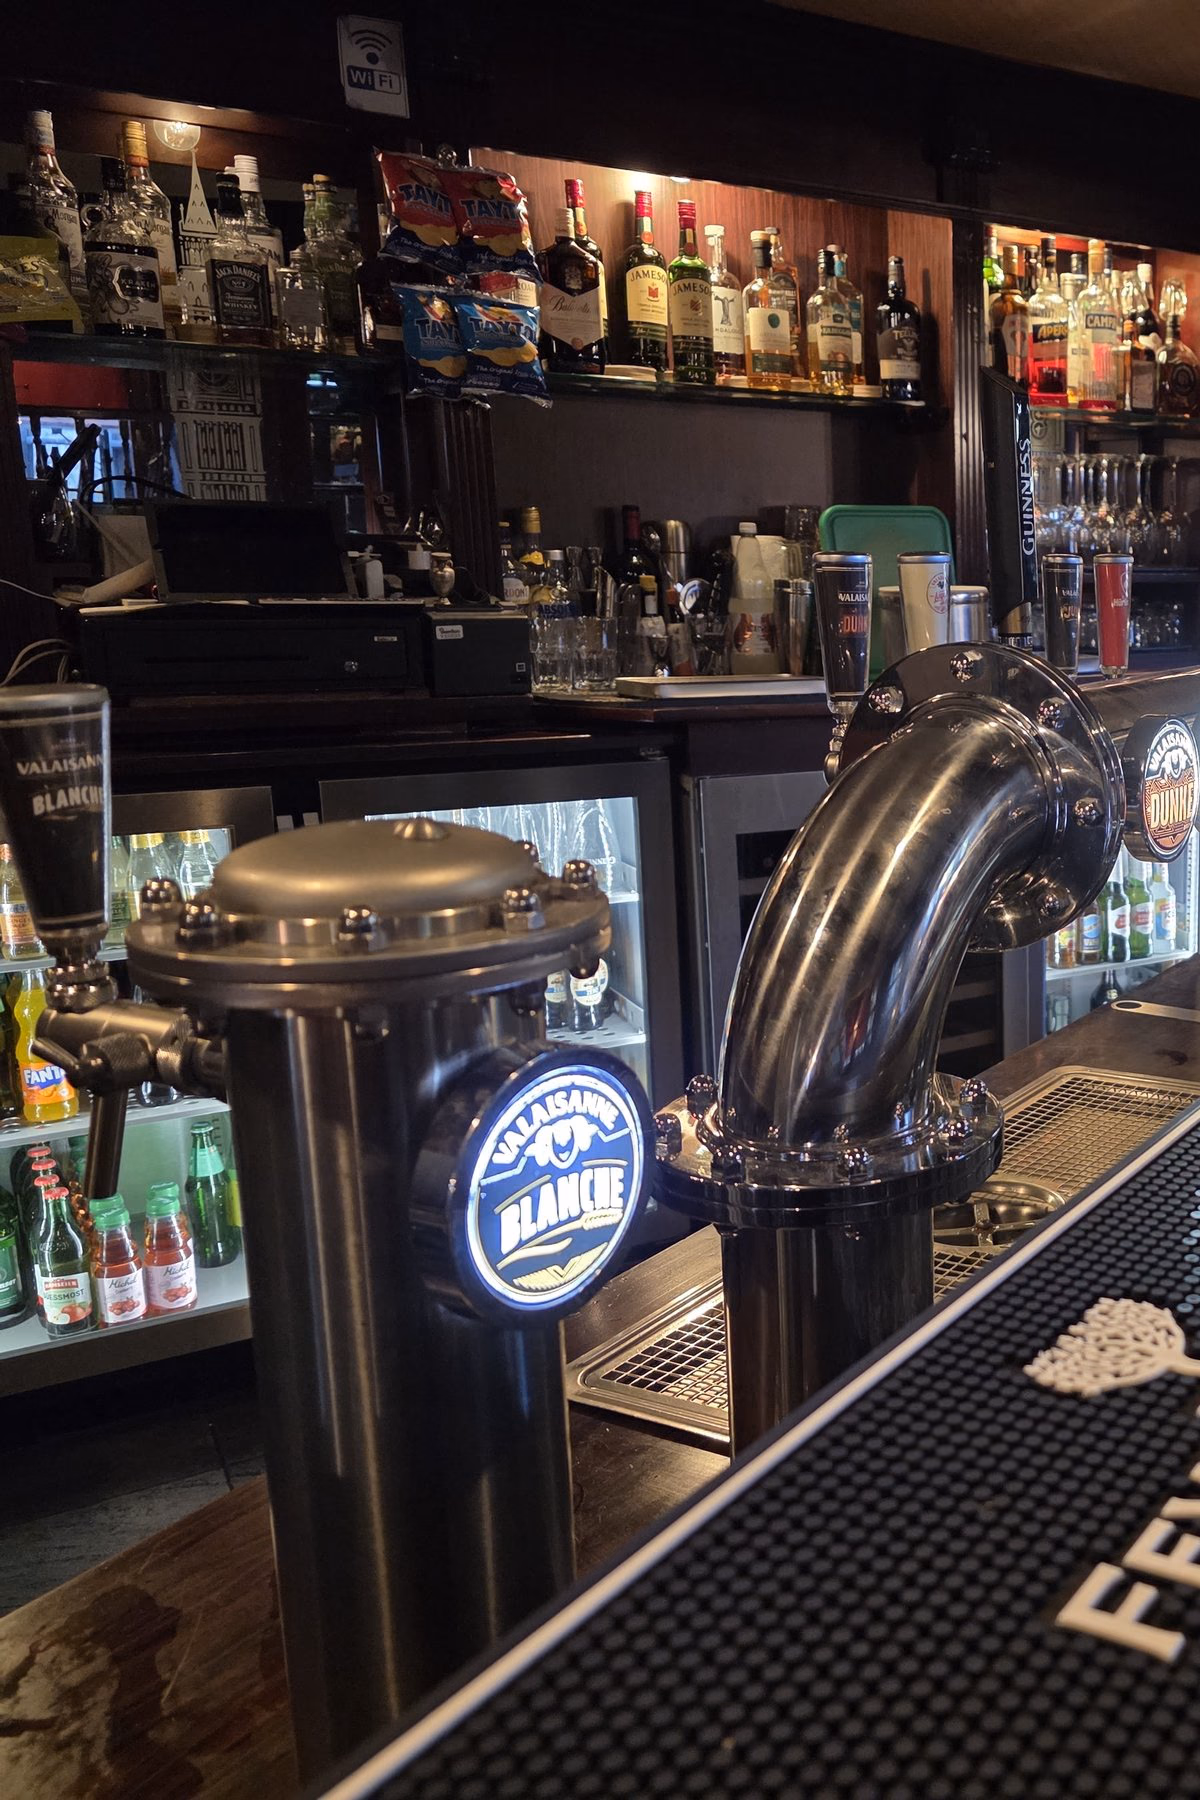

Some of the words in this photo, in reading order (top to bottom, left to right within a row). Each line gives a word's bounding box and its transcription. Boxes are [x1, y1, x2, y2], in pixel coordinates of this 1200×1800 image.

[397, 183, 453, 214] TAYT
[459, 199, 518, 220] TAYT
[215, 265, 232, 281] JACK
[629, 268, 668, 285] JAMESO
[672, 287, 711, 299] JAMESO
[1021, 437, 1036, 556] GUINNESS
[1150, 781, 1194, 829] DUNKE
[23, 1065, 67, 1085] FANT
[491, 1090, 620, 1165] VALAISANNE
[500, 1166, 625, 1256] BLANCHE
